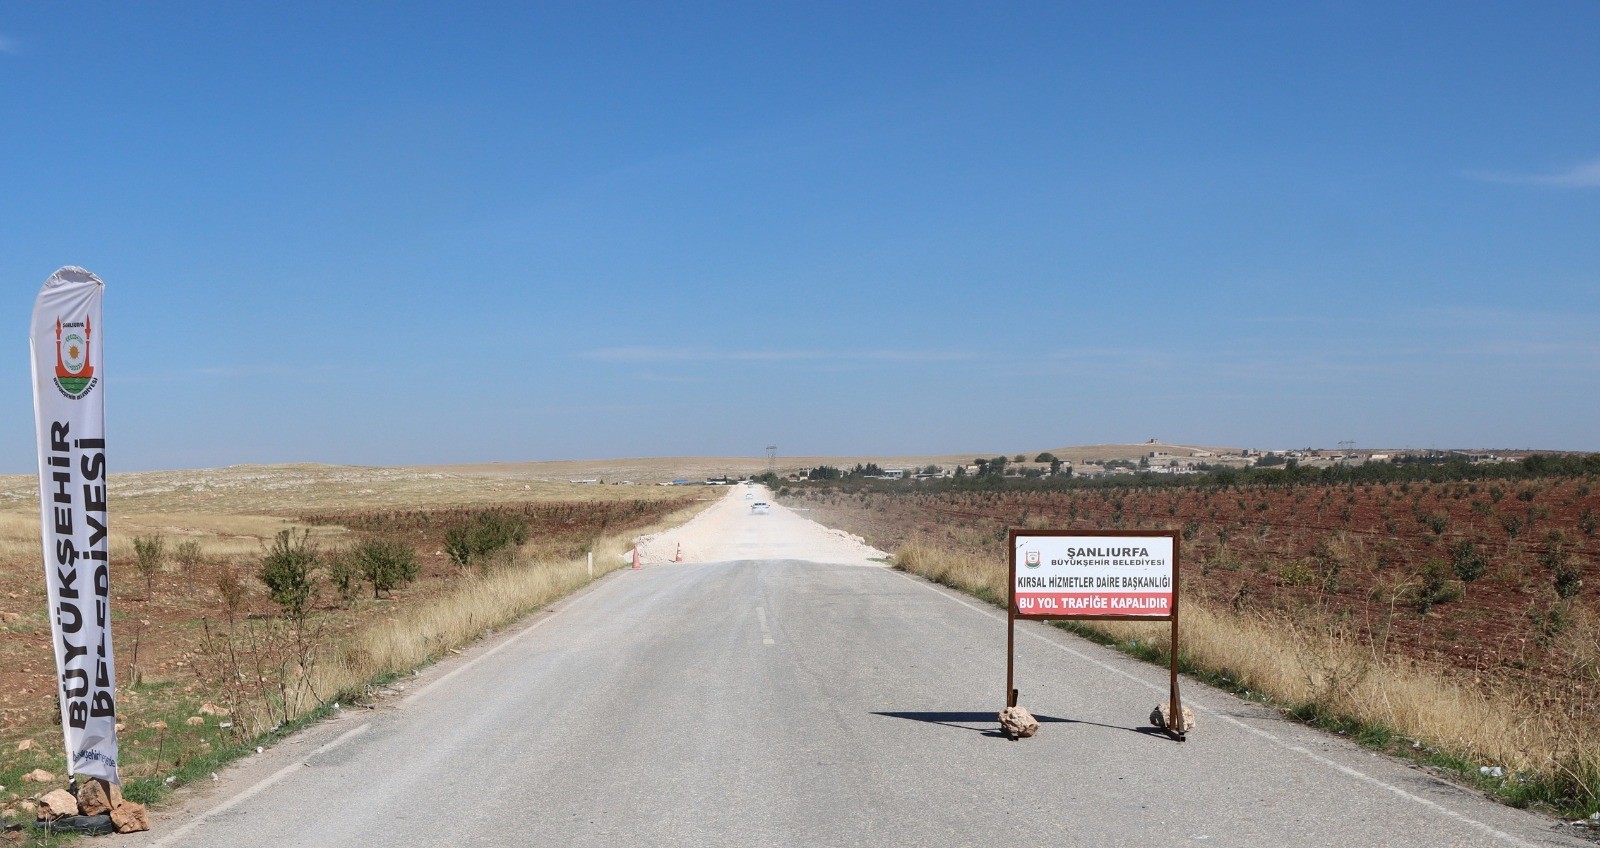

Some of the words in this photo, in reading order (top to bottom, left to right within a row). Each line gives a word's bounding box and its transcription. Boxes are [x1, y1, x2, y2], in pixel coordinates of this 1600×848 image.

[1067, 547, 1149, 559] ŞANLIURFA
[1051, 558, 1110, 567] BÜYÜKŞEHİR
[1112, 558, 1165, 566] BELEDİYESİ
[47, 421, 89, 730] BÜYÜKŞEHİR
[1017, 576, 1046, 588] KIRSAL
[1049, 574, 1094, 588] HİZMETLER
[1096, 574, 1120, 588] DAİRE
[1122, 574, 1171, 590] BAŞKANLIĞI
[1019, 597, 1034, 608] BU
[1037, 597, 1058, 608] YOL
[1061, 595, 1108, 608] TRAFİĞE
[1111, 597, 1168, 608] KAPALIDIR
